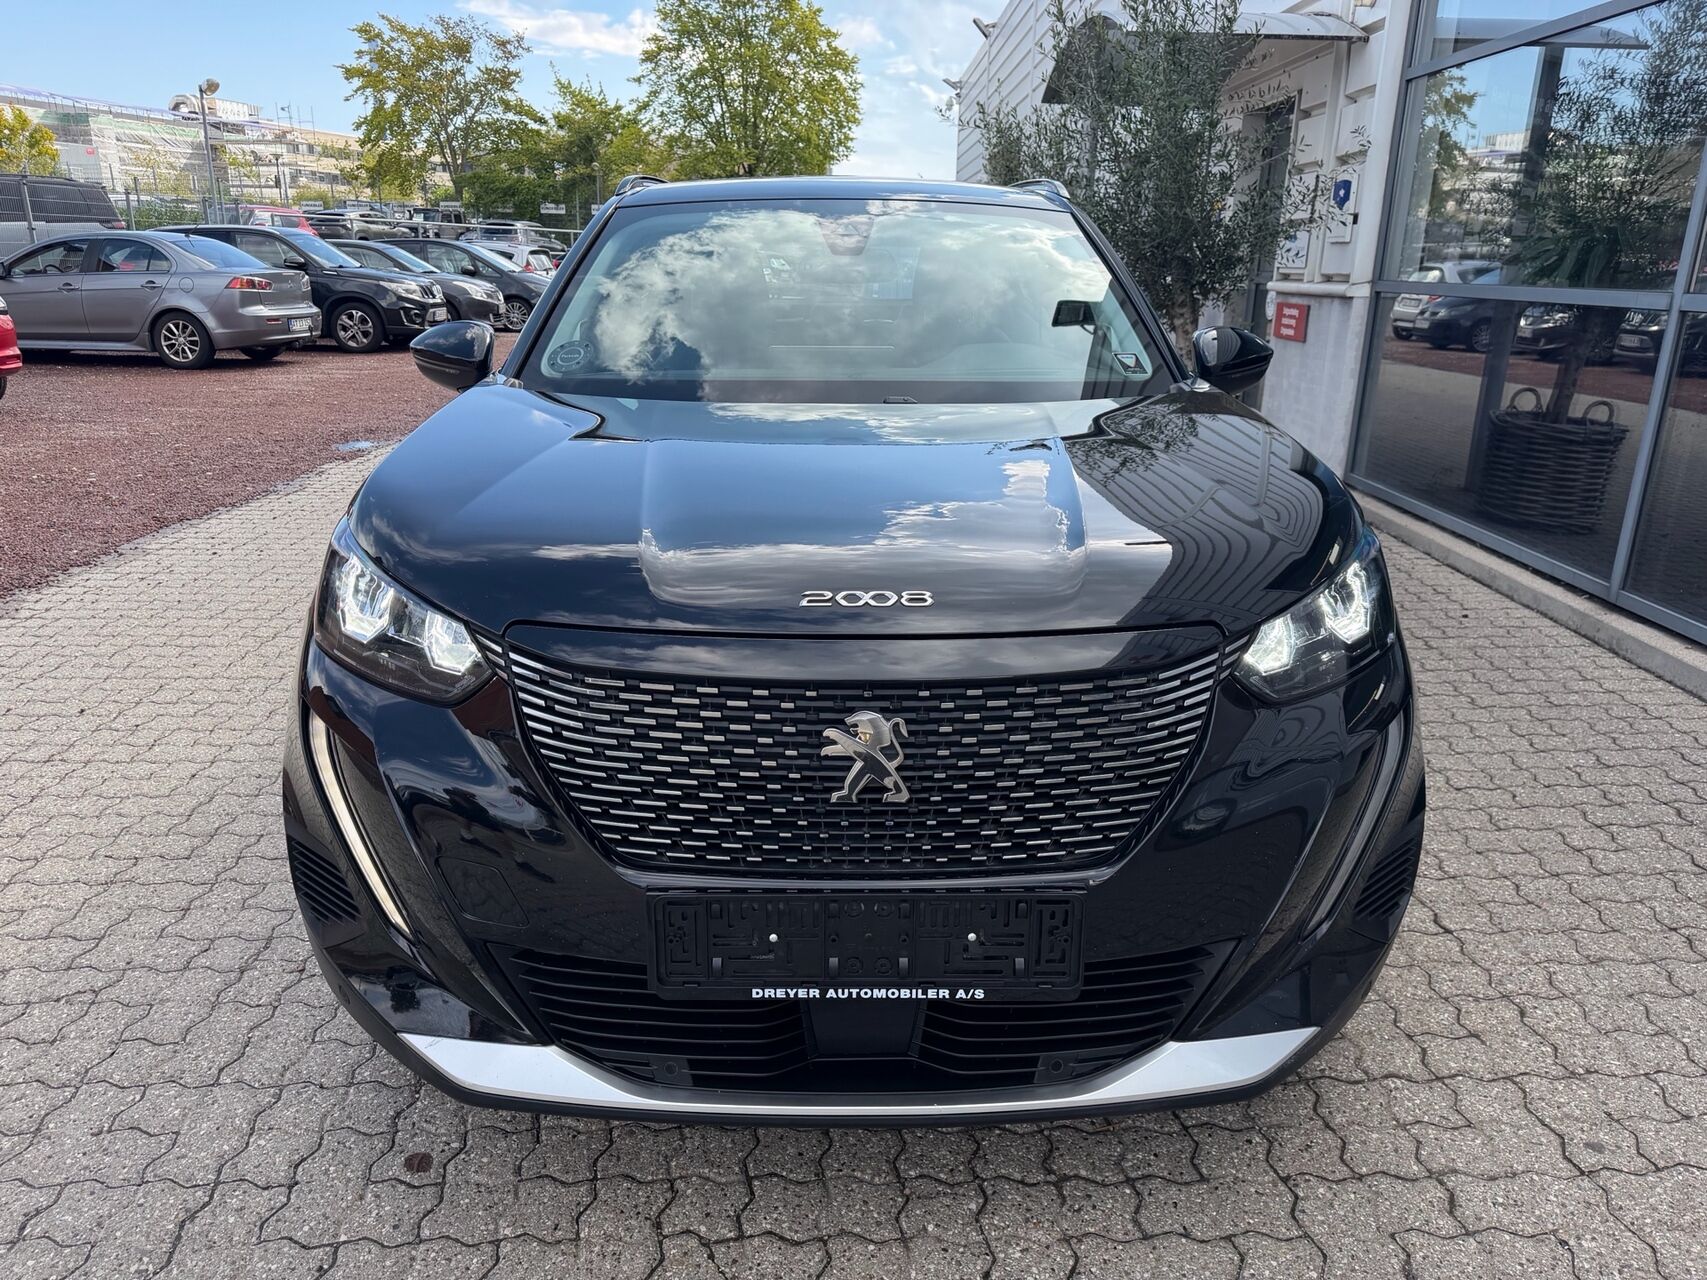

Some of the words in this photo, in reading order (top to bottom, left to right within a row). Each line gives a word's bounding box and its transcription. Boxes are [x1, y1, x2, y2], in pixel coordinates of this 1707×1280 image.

[799, 590, 934, 607] 2008
[752, 988, 820, 999] DREYER
[826, 988, 950, 999] AUTOMOBILER
[955, 988, 985, 1000] A/S
